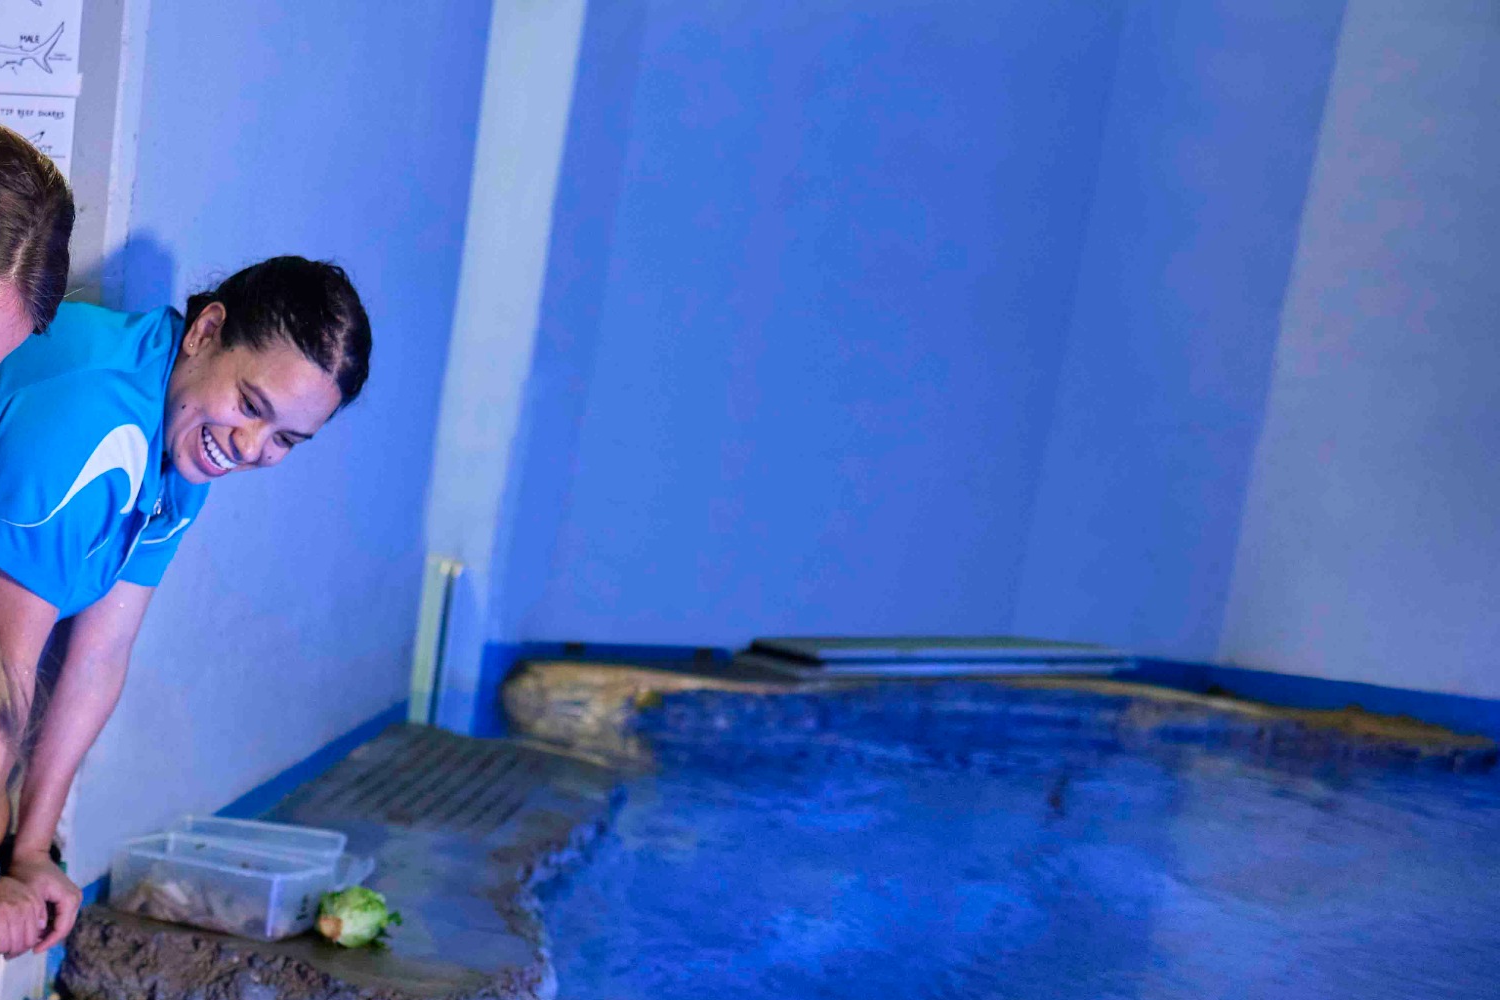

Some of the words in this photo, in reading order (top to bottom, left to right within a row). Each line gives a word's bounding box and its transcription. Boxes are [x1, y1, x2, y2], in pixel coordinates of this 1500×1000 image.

[20, 35, 40, 43] MALE
[0, 108, 14, 116] TIP
[38, 110, 65, 119] SHARKS
